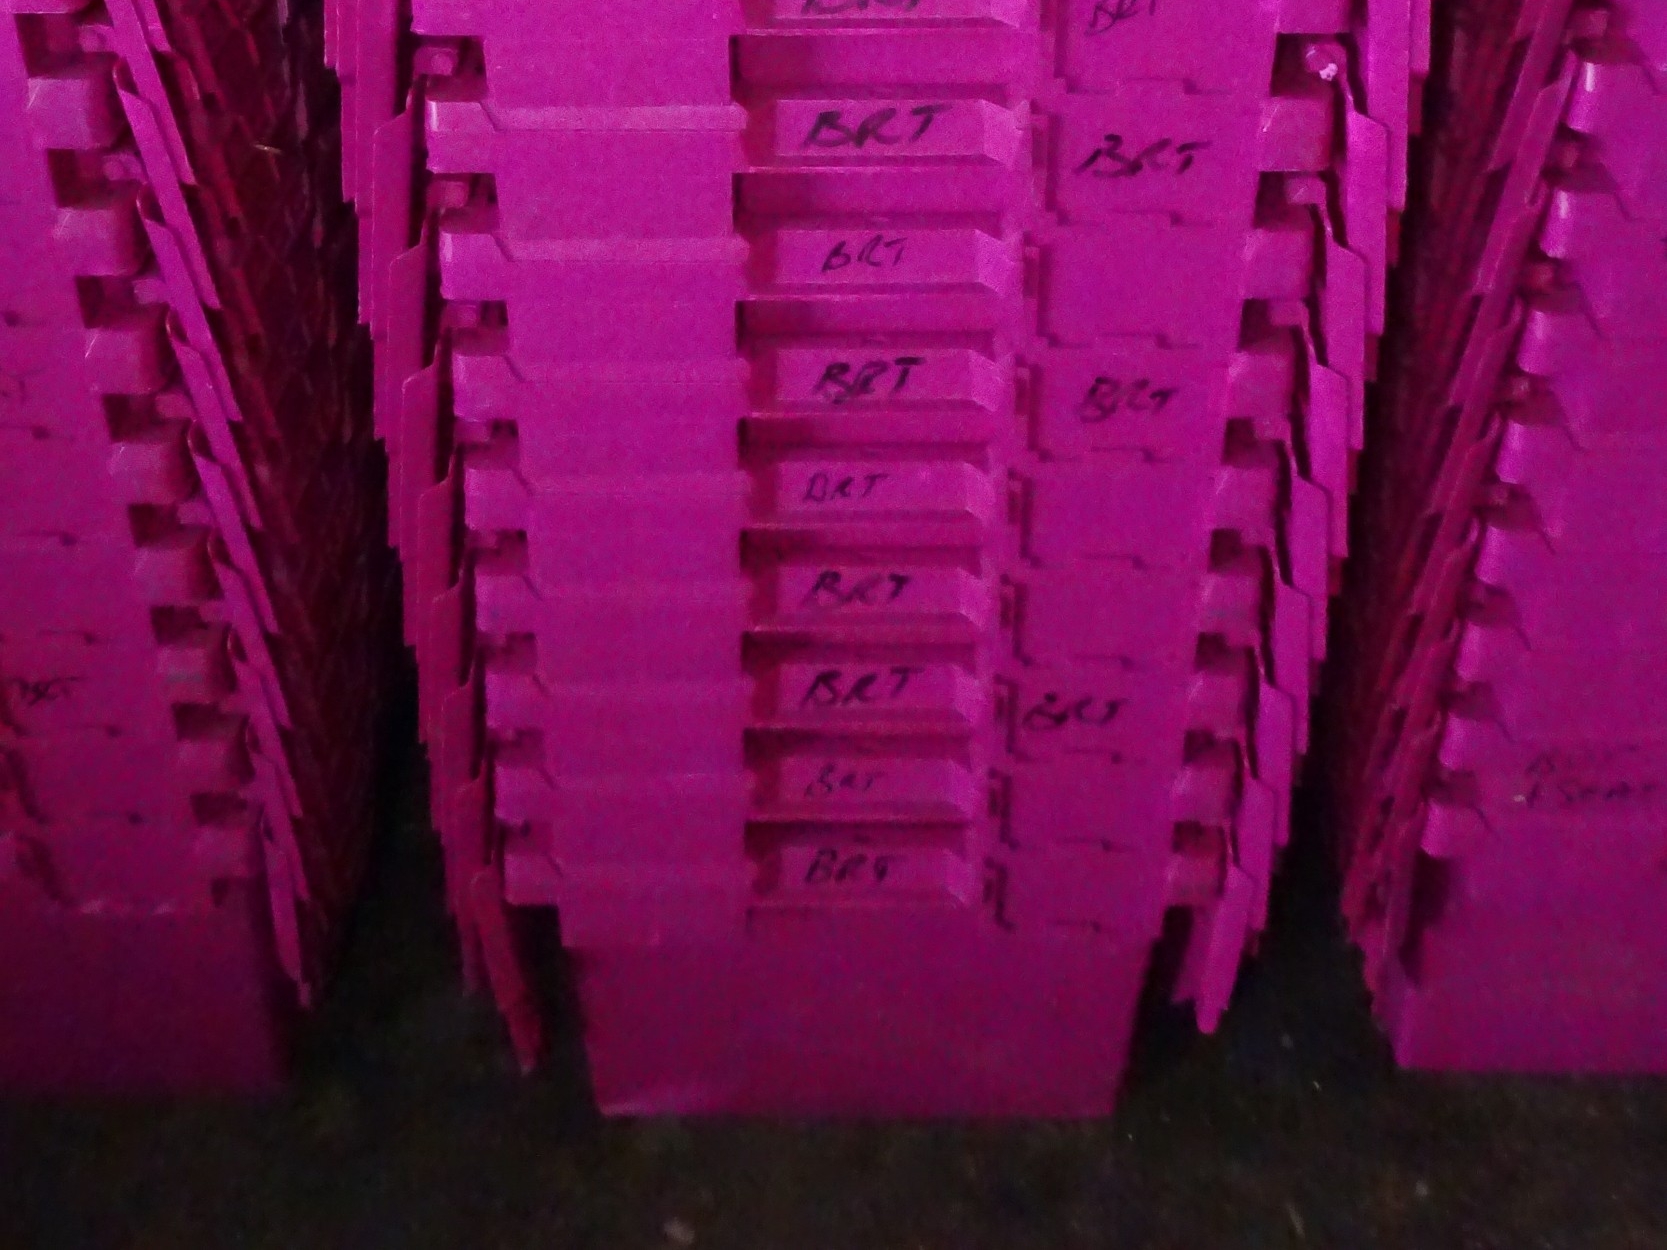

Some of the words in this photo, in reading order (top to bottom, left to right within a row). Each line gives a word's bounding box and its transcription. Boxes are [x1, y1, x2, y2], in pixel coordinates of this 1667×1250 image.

[804, 103, 952, 149] BRT
[822, 234, 908, 272] BRT
[803, 666, 926, 705] BRT
